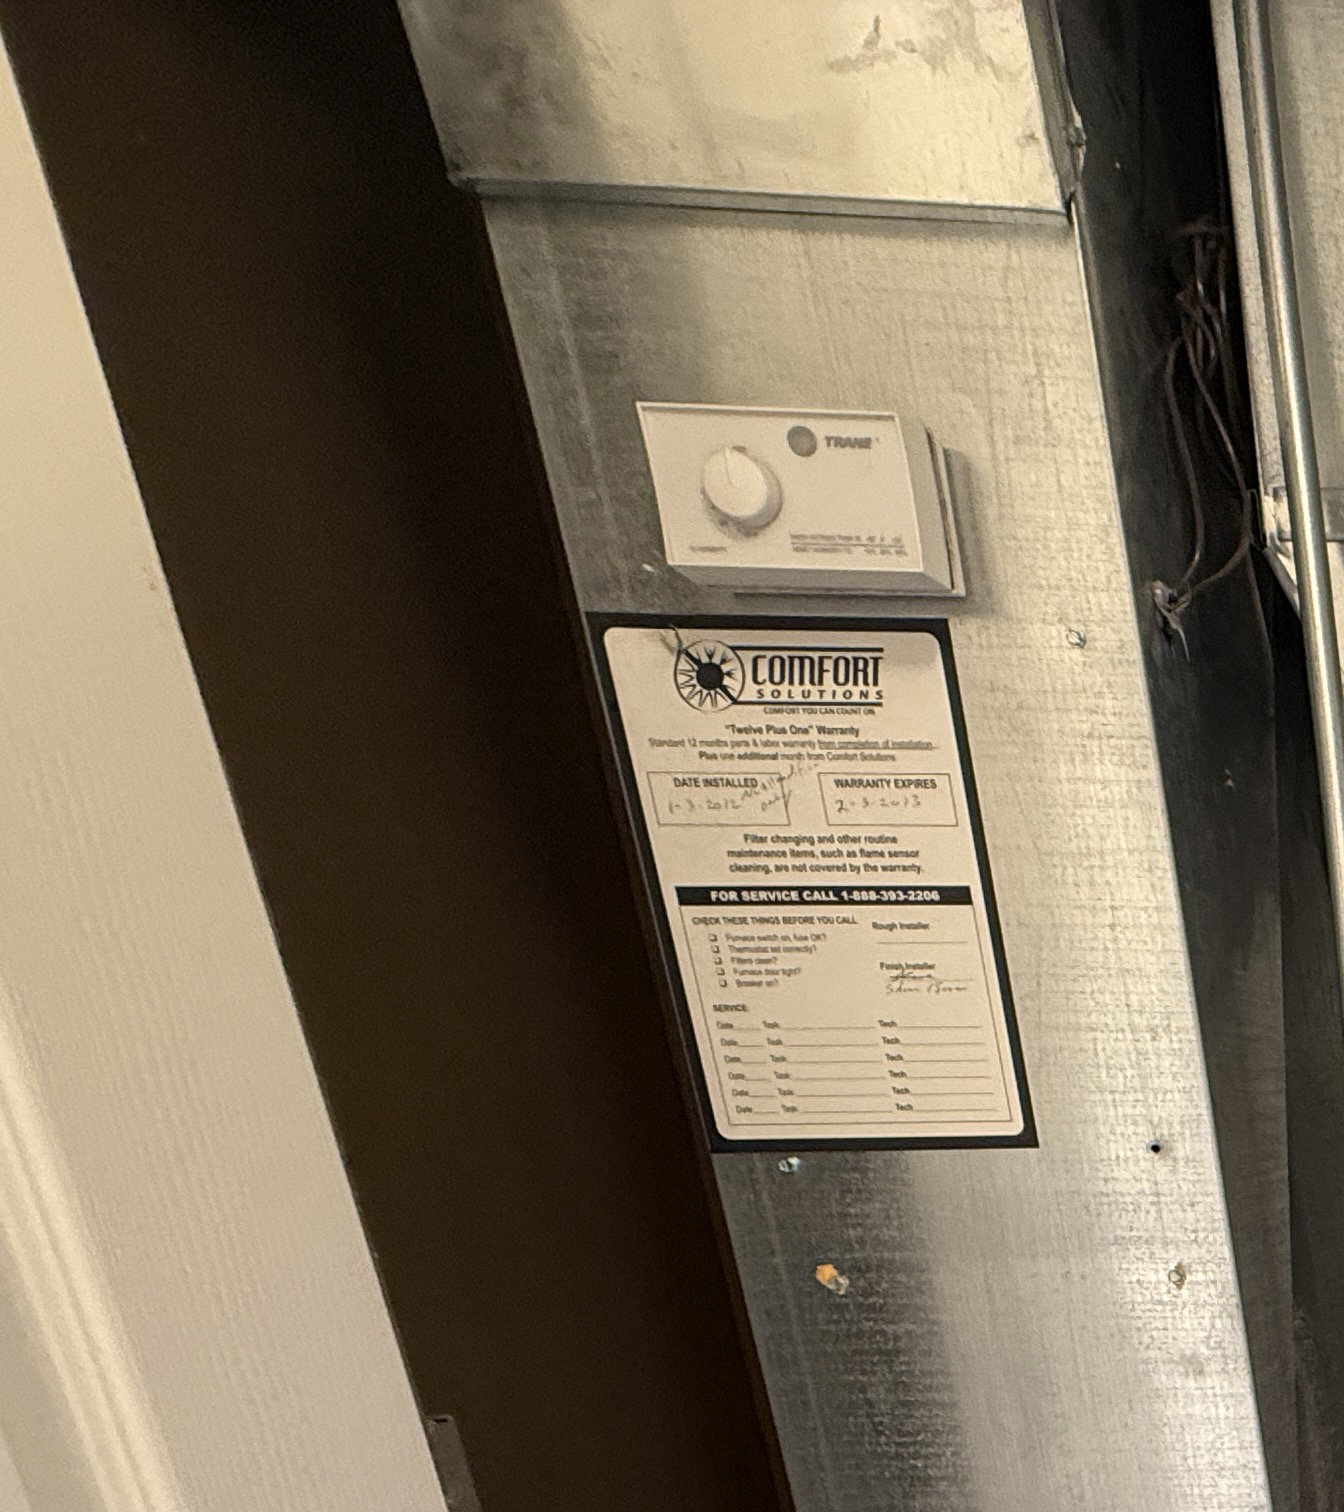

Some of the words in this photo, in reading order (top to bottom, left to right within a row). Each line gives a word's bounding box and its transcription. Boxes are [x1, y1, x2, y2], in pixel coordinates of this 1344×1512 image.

[824, 434, 873, 450] TRANE
[751, 654, 884, 687] COMFORT
[757, 688, 884, 701] SOLUTIONS
[764, 707, 801, 715] COMFORT
[836, 708, 862, 716] COUNT
[725, 724, 764, 736] "Twelve
[765, 724, 788, 735] Plus
[789, 724, 814, 736] One"
[816, 725, 860, 738] Warranty
[699, 751, 718, 761] Plus
[720, 752, 735, 760] one
[737, 752, 779, 761] additional
[780, 752, 805, 761] month
[806, 752, 825, 761] from
[826, 752, 859, 761] Comfort
[860, 752, 896, 762] Solutions
[673, 777, 701, 788] DATE
[703, 778, 758, 788] INSTALLED
[833, 778, 892, 789] WARRANTY
[894, 779, 937, 790] EXPIRES
[743, 833, 768, 844] Filter
[770, 834, 815, 846] changing
[817, 834, 835, 844] and
[837, 834, 862, 844] other
[864, 834, 897, 844] routine
[726, 849, 787, 858] maintenance
[789, 849, 819, 859] items,
[820, 848, 844, 858] such
[846, 850, 857, 858] as
[860, 849, 885, 858] flame
[888, 850, 919, 858] sensor
[729, 863, 773, 875] cleaning,
[791, 863, 807, 872] not
[809, 863, 847, 872] covered
[849, 863, 861, 874] by
[863, 863, 878, 872] the
[880, 865, 924, 875] warranty.
[710, 890, 738, 901] FOR
[741, 890, 799, 901] SERVICE
[803, 890, 838, 901] CALL
[691, 916, 721, 925] CHECK
[722, 916, 749, 925] THESE
[750, 916, 780, 925] THINGS
[782, 915, 815, 925] BEFORE
[816, 915, 835, 924] YOU
[836, 915, 858, 924] CALL
[872, 921, 897, 932] Rough
[899, 921, 930, 931] Installer
[905, 962, 936, 971] Installer
[712, 1004, 748, 1012] SERVICE
[878, 1020, 897, 1028] Tech
[881, 1037, 900, 1045] Tech
[885, 1053, 904, 1062] Tech
[888, 1070, 907, 1079] Tech
[892, 1087, 910, 1095] Tech
[895, 1103, 913, 1112] Tech
